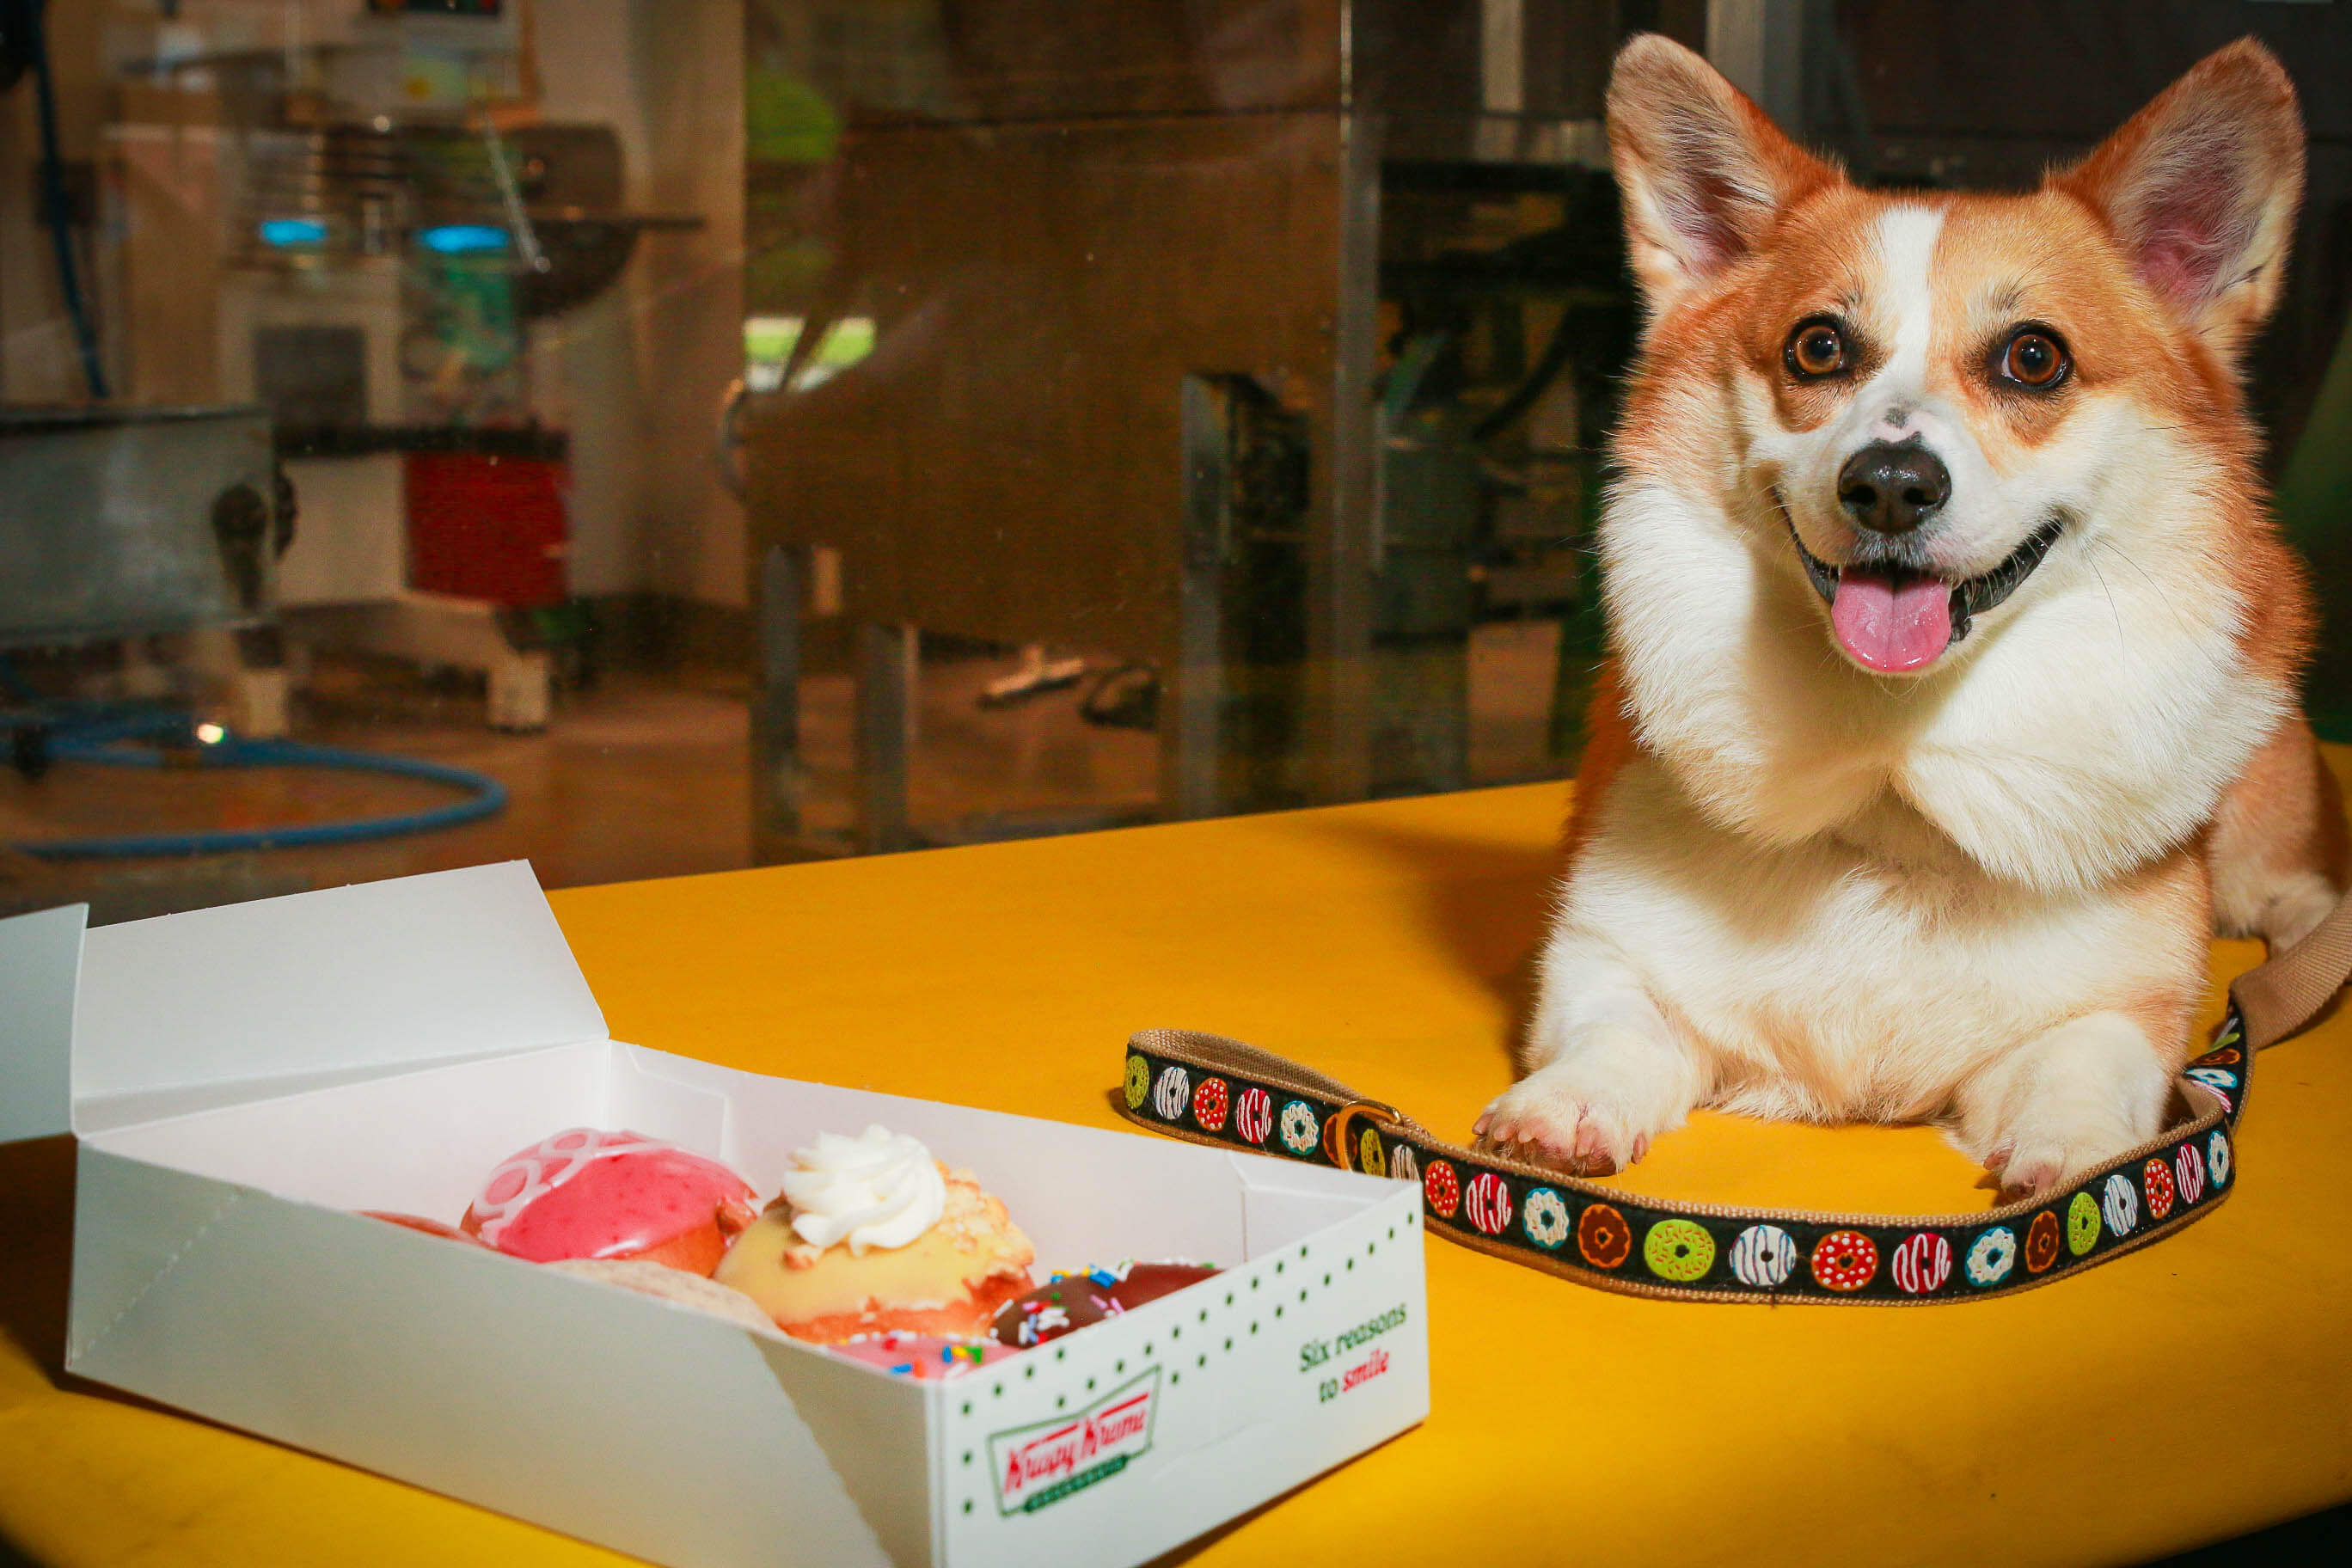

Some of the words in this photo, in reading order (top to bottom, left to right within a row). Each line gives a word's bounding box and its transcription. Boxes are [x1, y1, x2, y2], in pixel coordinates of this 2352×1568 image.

[1300, 1338, 1331, 1372] Six
[1336, 1302, 1407, 1356] reasons
[1320, 1378, 1338, 1402] to
[1342, 1347, 1390, 1392] smile
